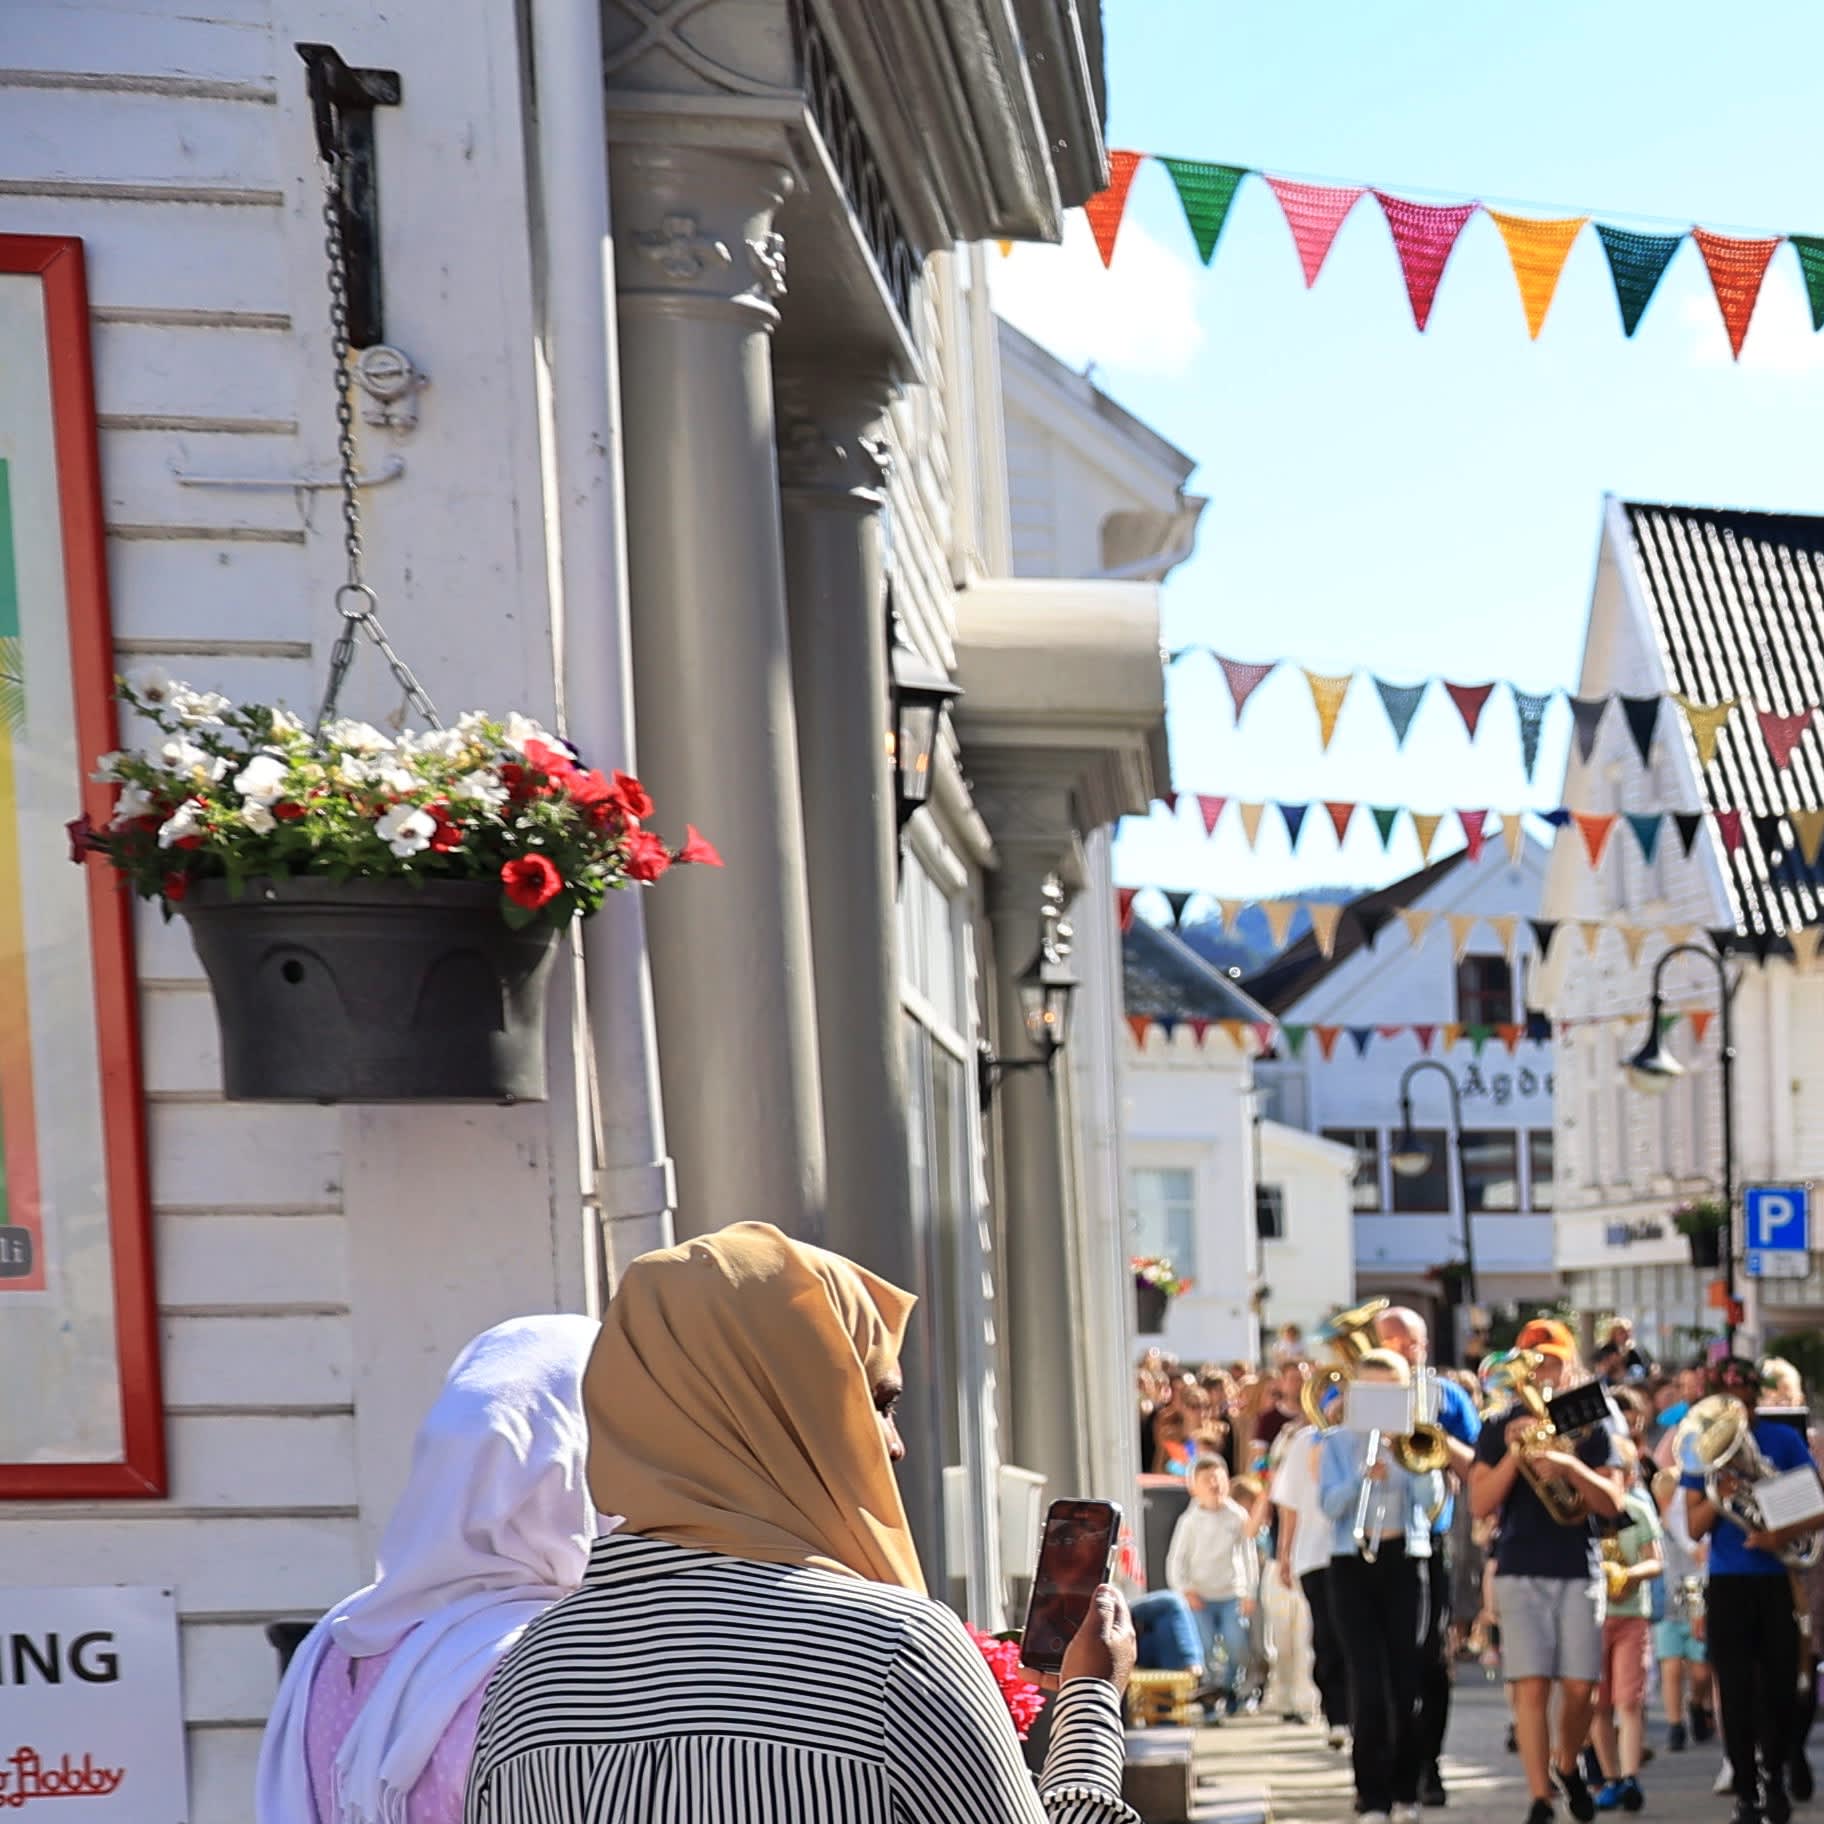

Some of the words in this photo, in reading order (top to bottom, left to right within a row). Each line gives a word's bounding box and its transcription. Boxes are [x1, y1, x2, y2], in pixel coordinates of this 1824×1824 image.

[1758, 1195, 1795, 1245] P
[0, 1631, 120, 1684] NG
[7, 1746, 125, 1797] Hobby
